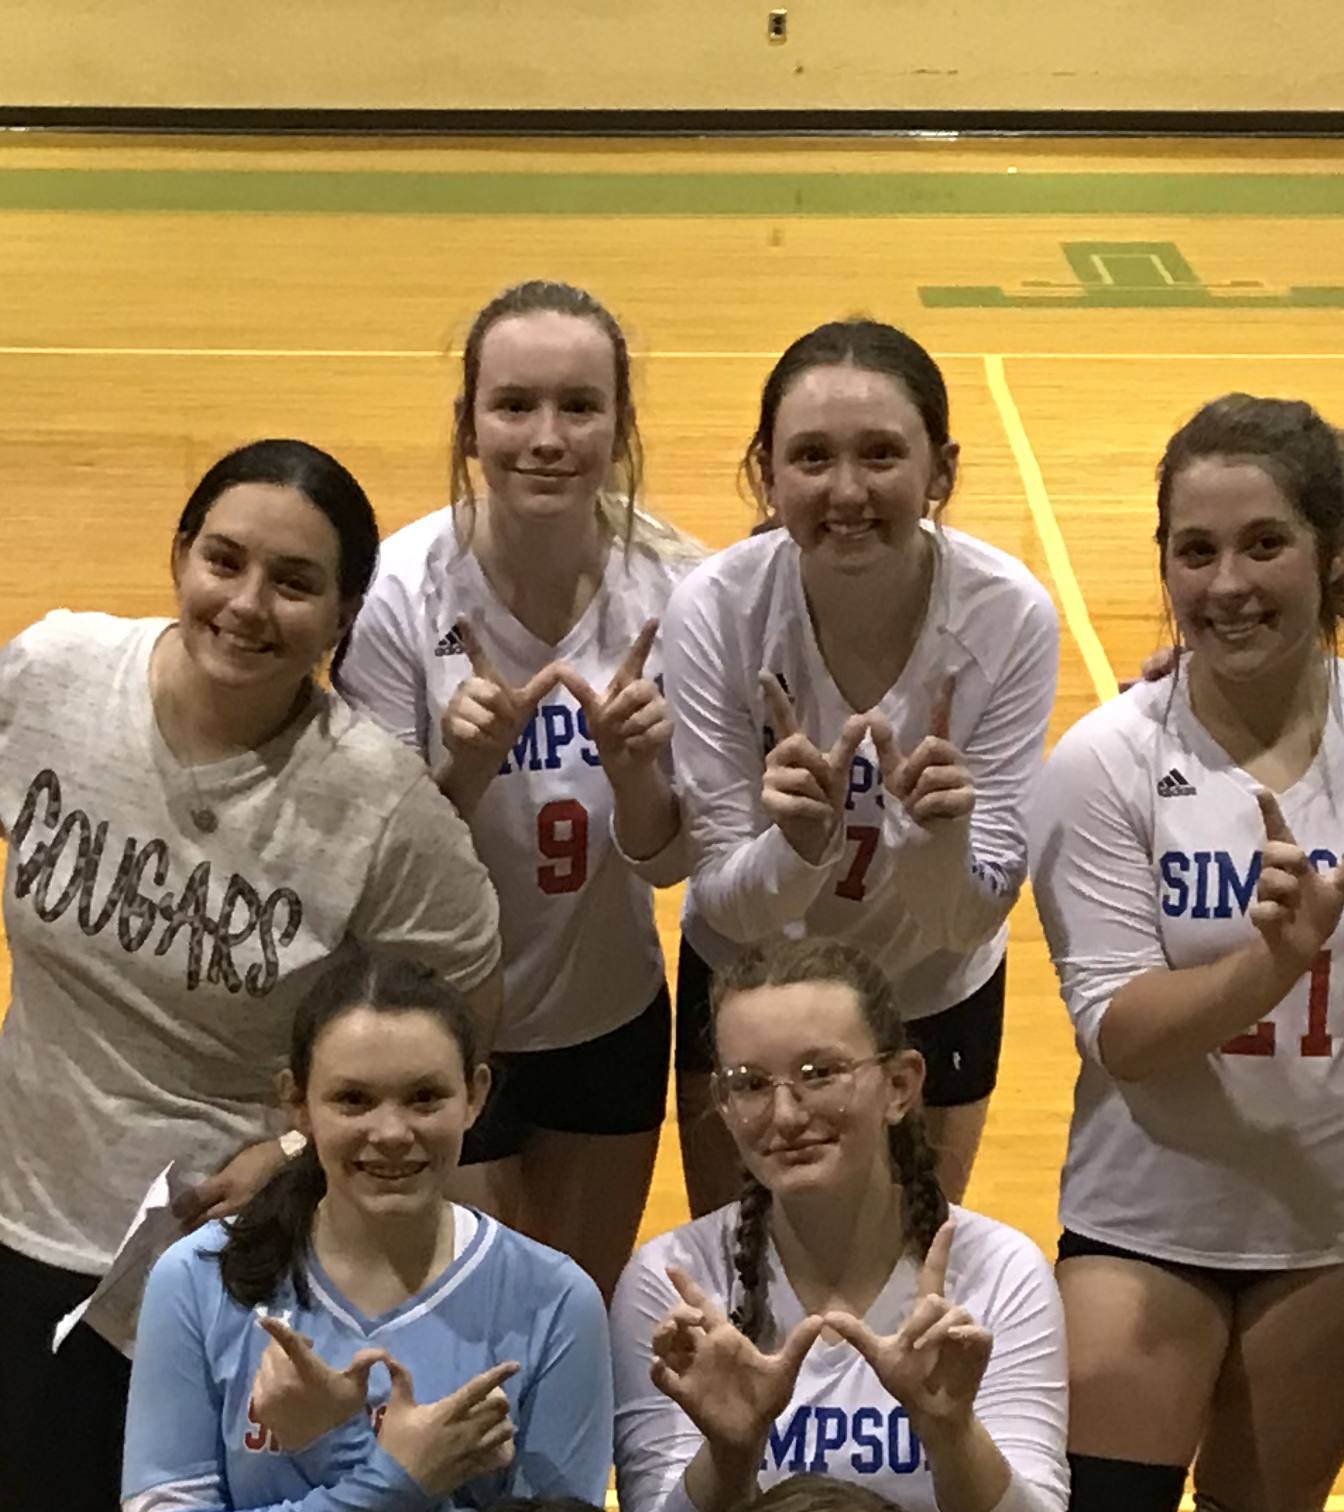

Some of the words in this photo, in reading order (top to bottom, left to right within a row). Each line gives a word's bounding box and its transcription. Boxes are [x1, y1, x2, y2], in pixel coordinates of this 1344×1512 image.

[12, 768, 303, 998] COUGARS
[537, 799, 588, 894] 9
[835, 826, 881, 901] 7
